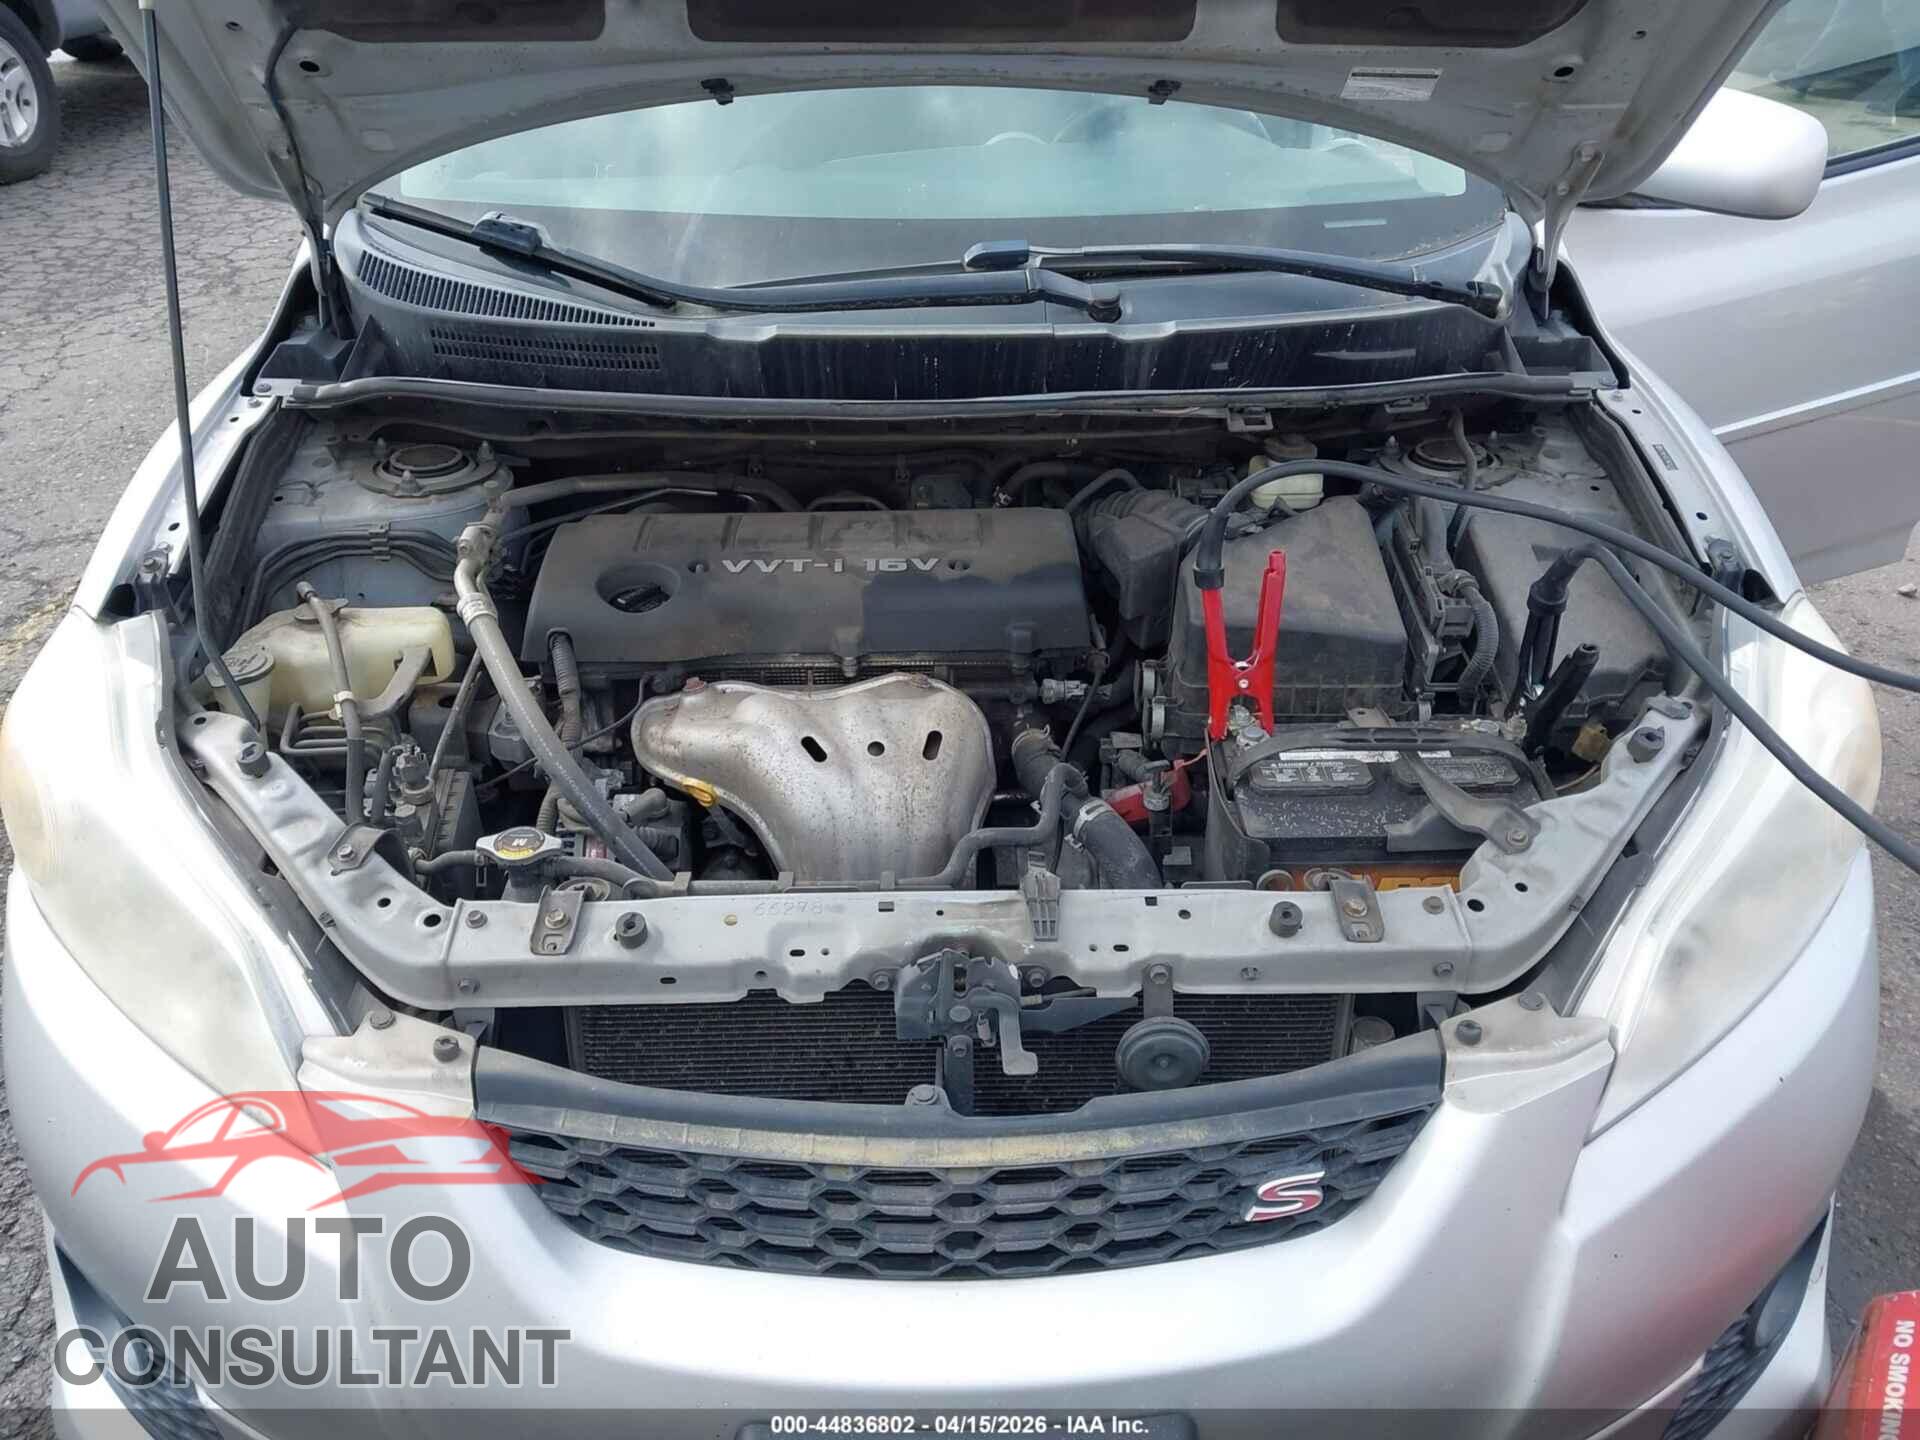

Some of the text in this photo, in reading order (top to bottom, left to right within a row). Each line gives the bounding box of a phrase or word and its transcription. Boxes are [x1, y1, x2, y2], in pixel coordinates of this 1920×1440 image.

[863, 557, 939, 572] 16V
[1245, 1170, 1324, 1222] S
[1893, 1319, 1916, 1348] NO
